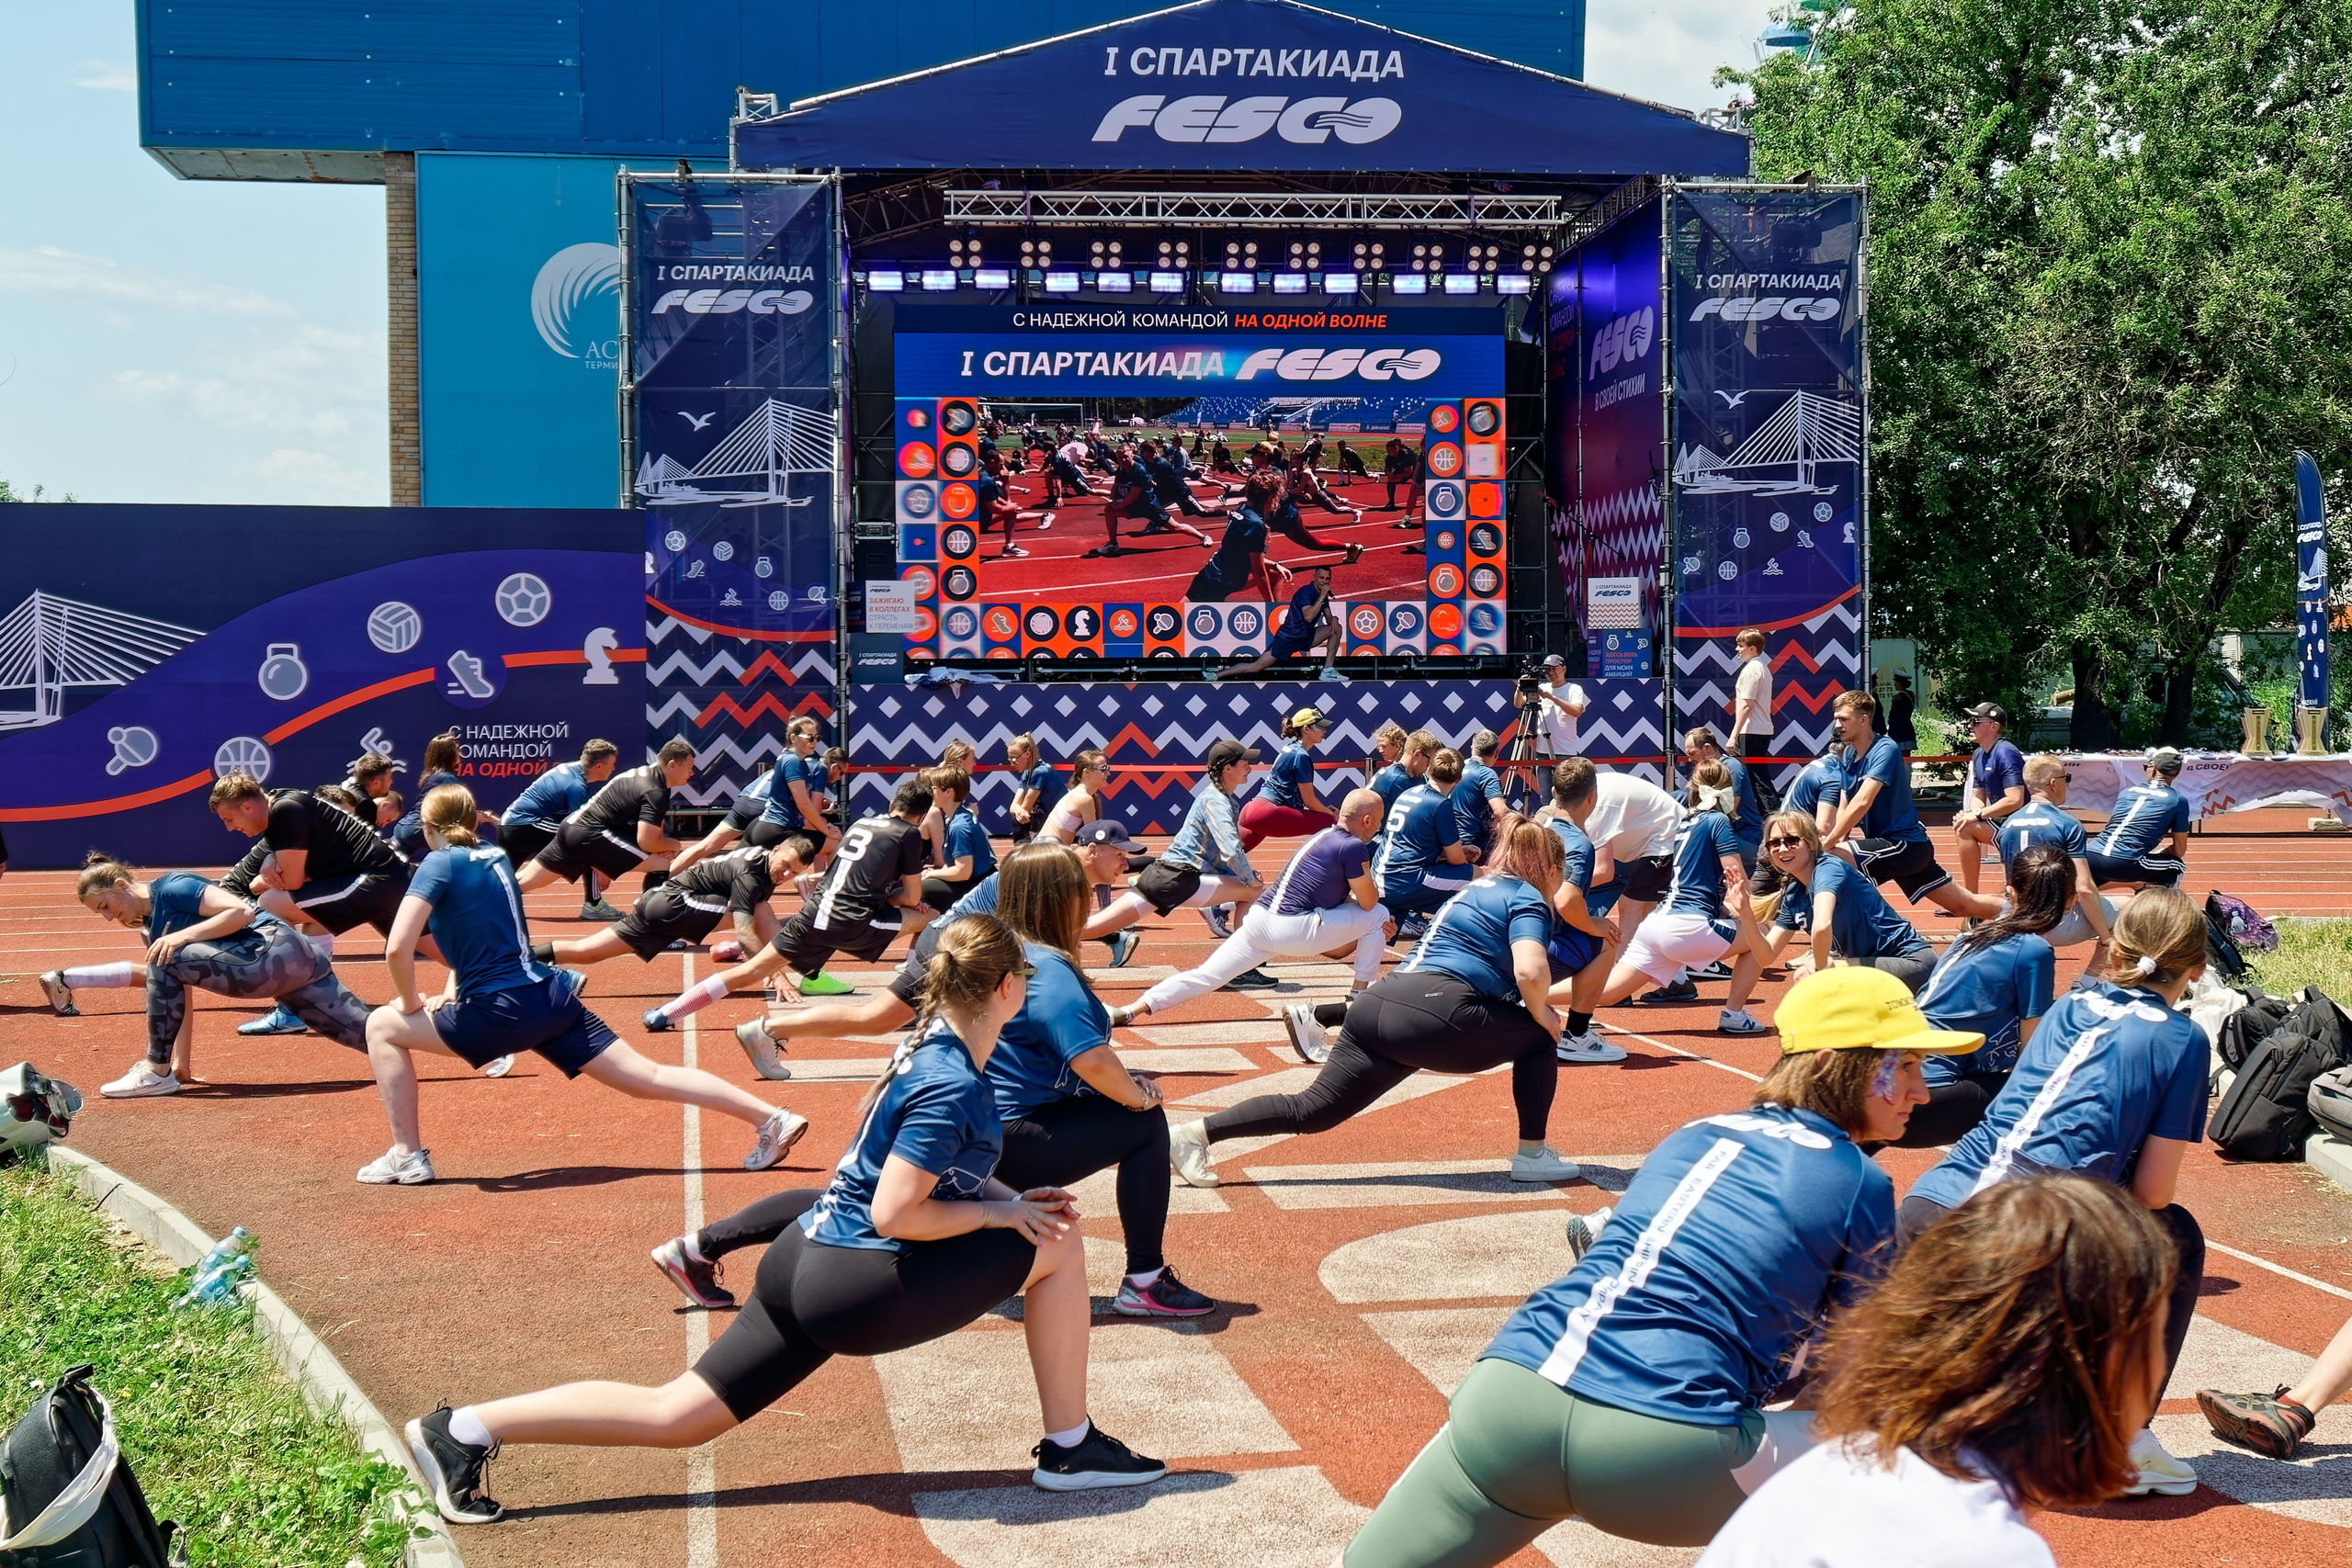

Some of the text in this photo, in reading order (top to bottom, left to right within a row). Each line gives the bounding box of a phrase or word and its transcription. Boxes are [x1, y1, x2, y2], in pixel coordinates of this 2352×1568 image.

[1104, 47, 1405, 83] I СПАРТАКИАДА
[1091, 95, 1402, 144] FESCO
[671, 265, 815, 283] СПАРТАКИАДА
[1708, 274, 1842, 290] СПАРТАКИАДА
[650, 288, 814, 315] FESCO
[1688, 297, 1841, 321] FESCO
[1012, 310, 1388, 331] С НАДЕЖНОЙ КОМАНДОЙ НА ОДНОЙ ВОЛНЕ
[584, 340, 618, 359] АС
[1589, 305, 1654, 381] FESCO
[584, 361, 618, 369] ТЕРМИ
[983, 351, 1225, 380] СПАРТАКИАДА
[1235, 348, 1442, 380] FESCO
[1594, 373, 1646, 412] В СВОЕЙ СТИХИИ
[466, 720, 570, 740] НАДЕЖНОЙ
[458, 740, 552, 760] ОМАНДОЙ
[479, 759, 549, 778] ОДНОЙ
[1385, 803, 1411, 832] 5
[836, 827, 874, 862] 3
[1673, 830, 1691, 865] 7
[1794, 911, 1808, 930] 5
[1657, 1178, 1703, 1234] EASTERN
[1626, 1236, 1655, 1284] SHIPPIN
